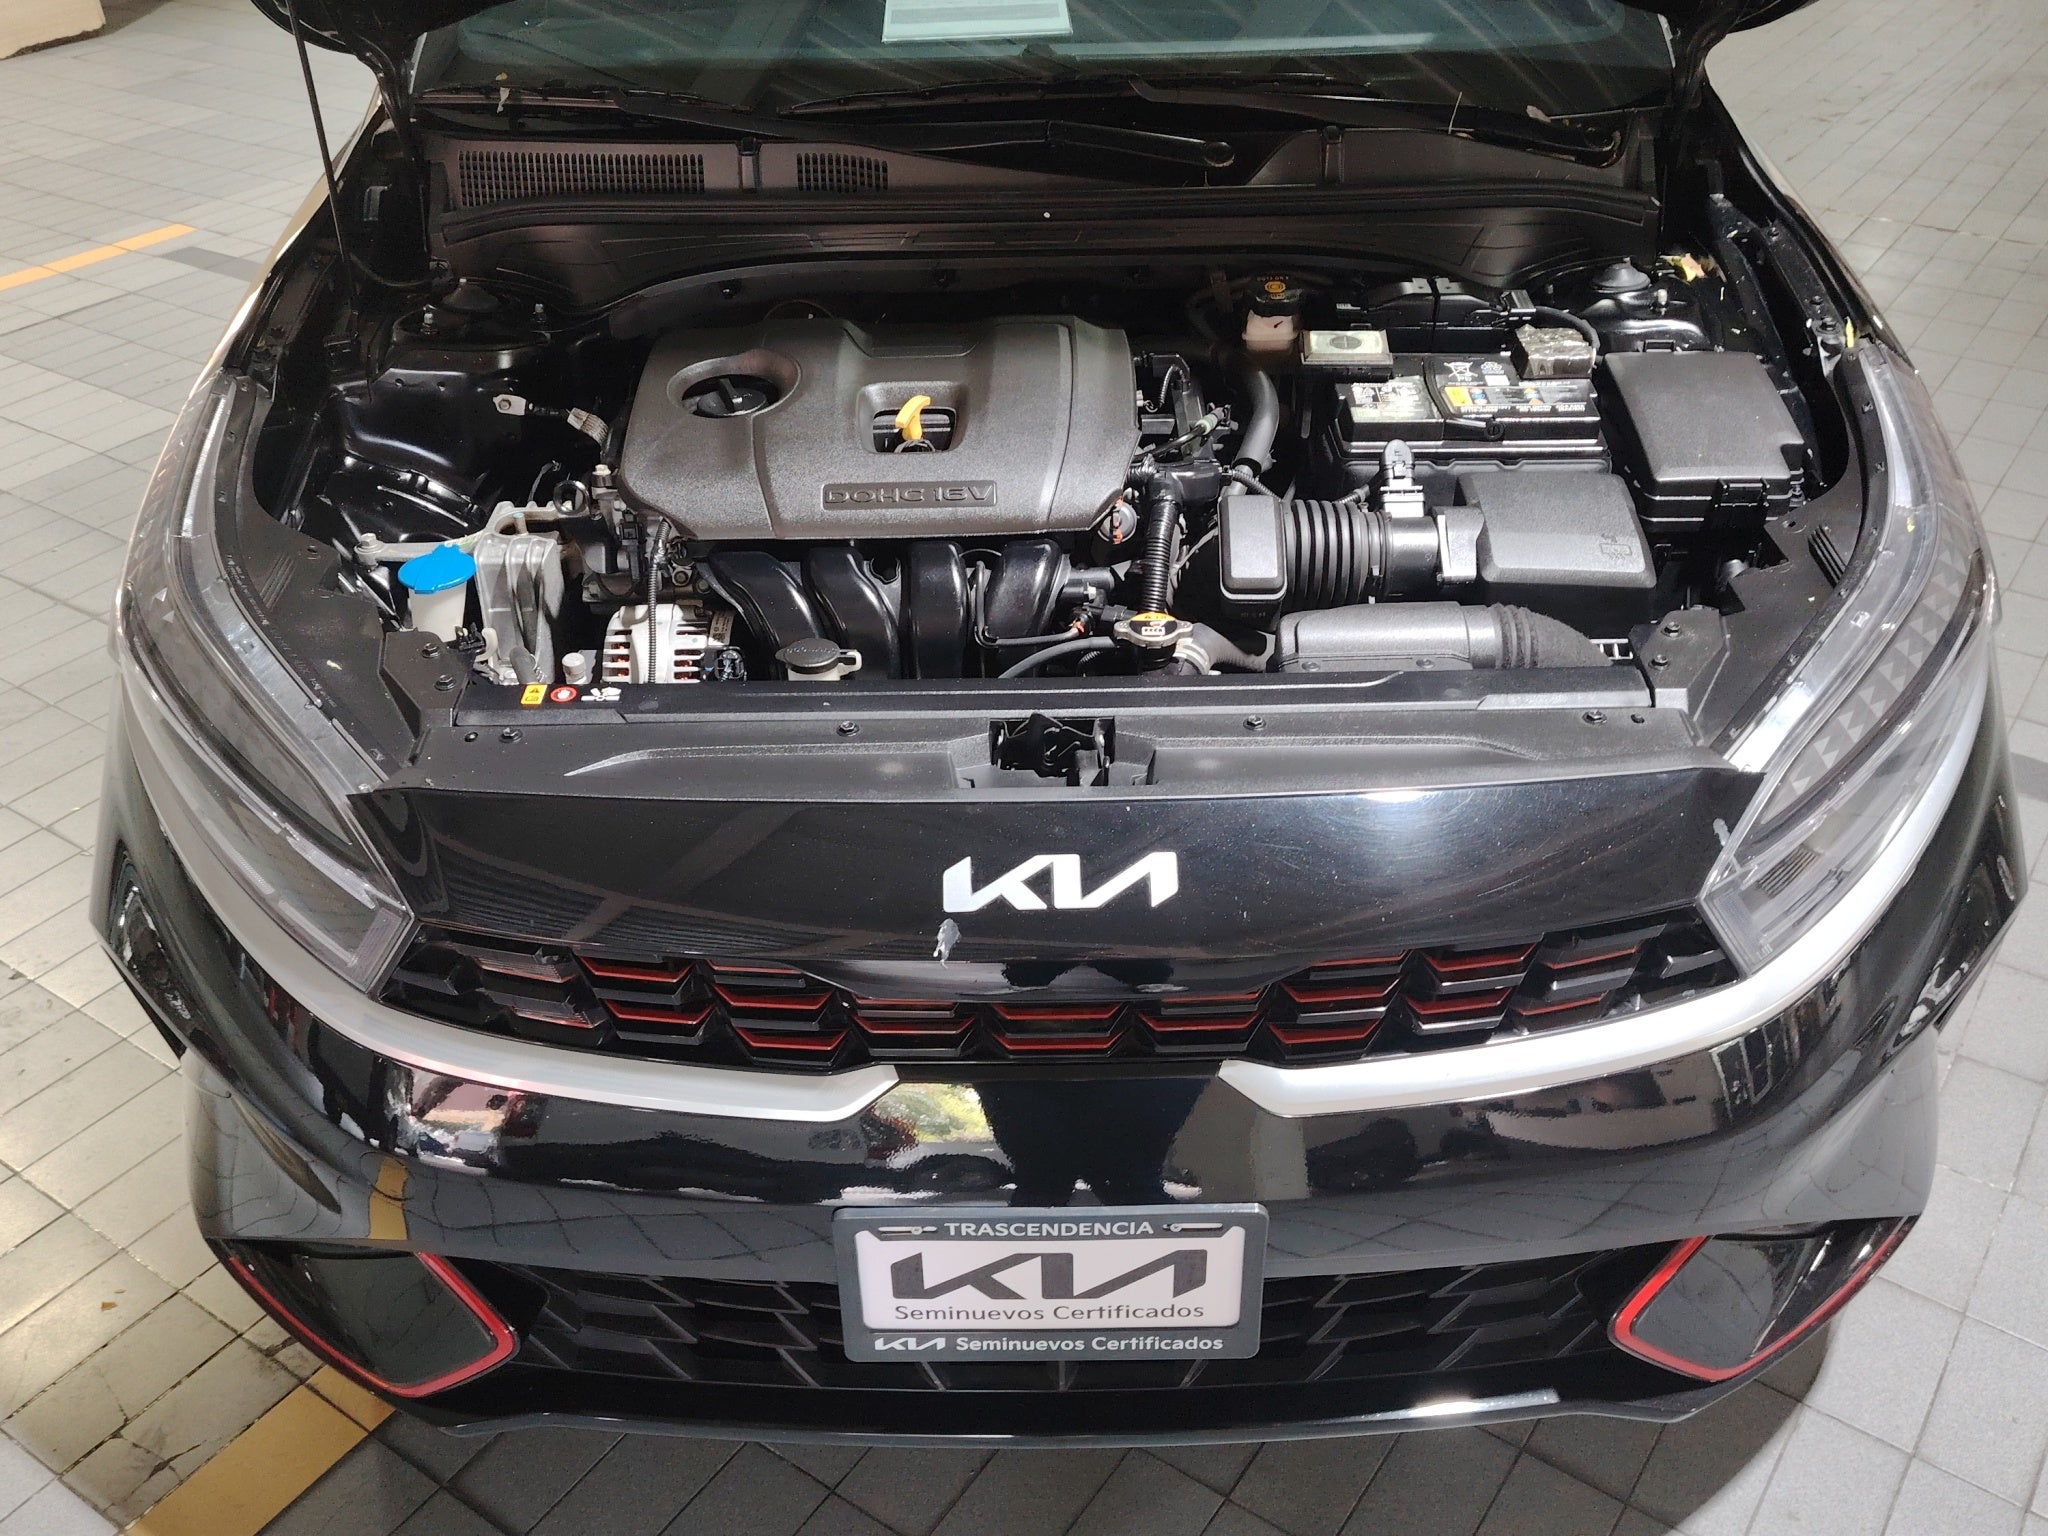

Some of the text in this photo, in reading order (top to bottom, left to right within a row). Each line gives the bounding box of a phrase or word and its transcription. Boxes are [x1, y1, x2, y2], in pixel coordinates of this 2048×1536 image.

[825, 484, 994, 504] DOHC 16V
[943, 851, 1178, 912] KIA
[944, 1221, 1154, 1237] TRASCENDENCIA
[890, 1249, 1208, 1300] KIA
[895, 1303, 1204, 1321] Seminuevos Certificados
[874, 1335, 1224, 1351] KIA Seminuevos Certificados
